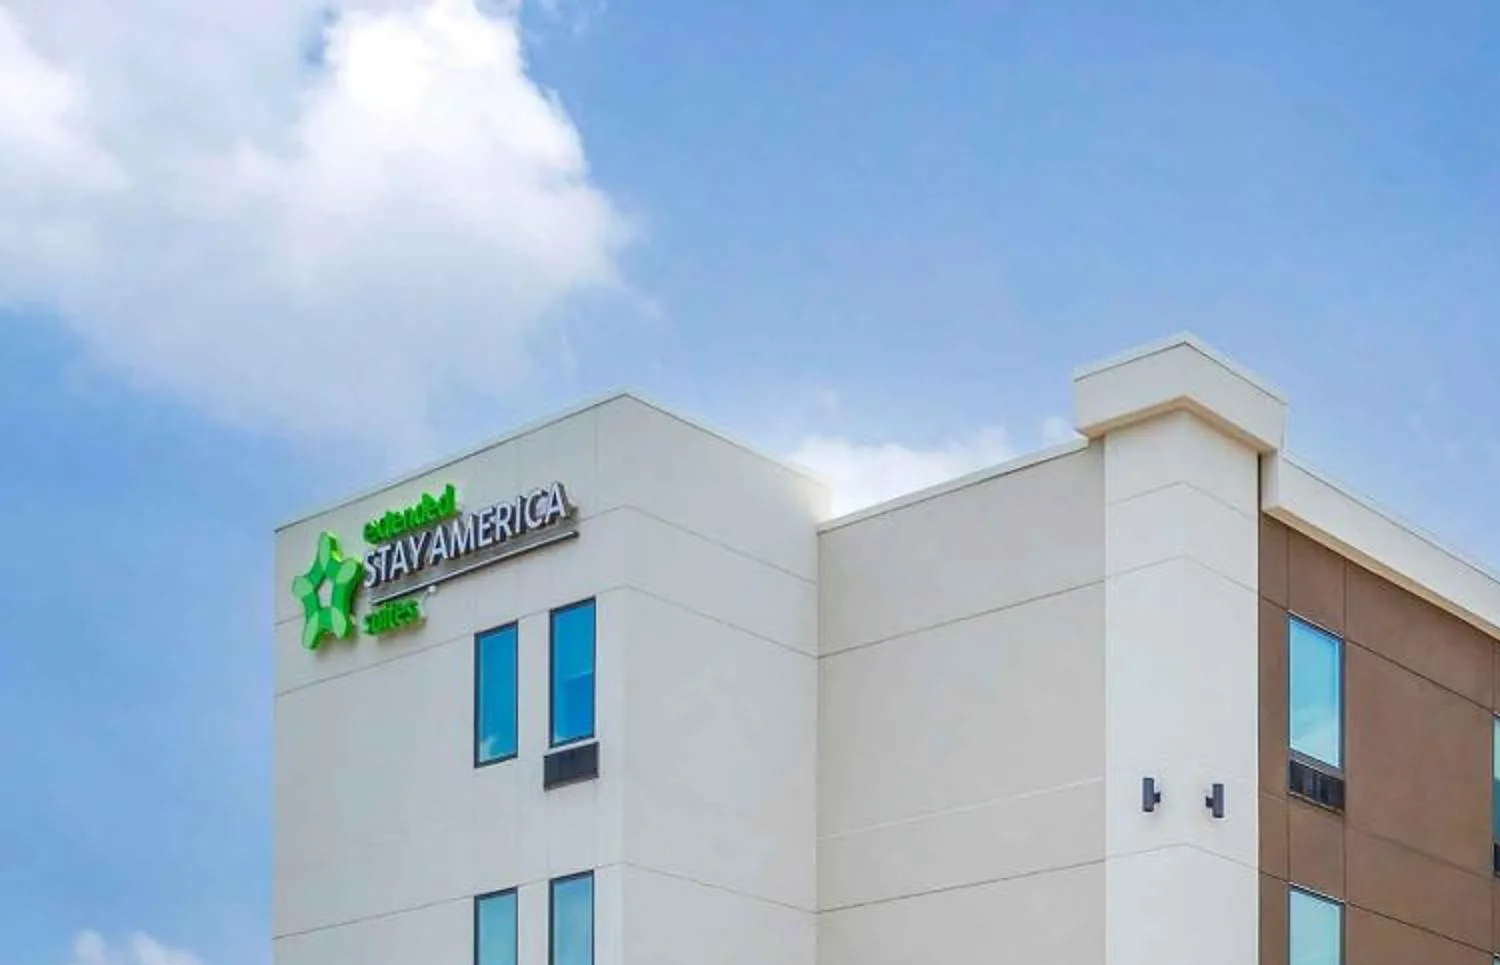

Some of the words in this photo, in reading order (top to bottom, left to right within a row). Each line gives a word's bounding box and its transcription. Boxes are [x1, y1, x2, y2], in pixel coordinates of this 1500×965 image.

[364, 484, 457, 542] extended
[364, 531, 427, 588] STAY
[429, 481, 567, 564] AMERICA
[364, 600, 419, 635] suites
